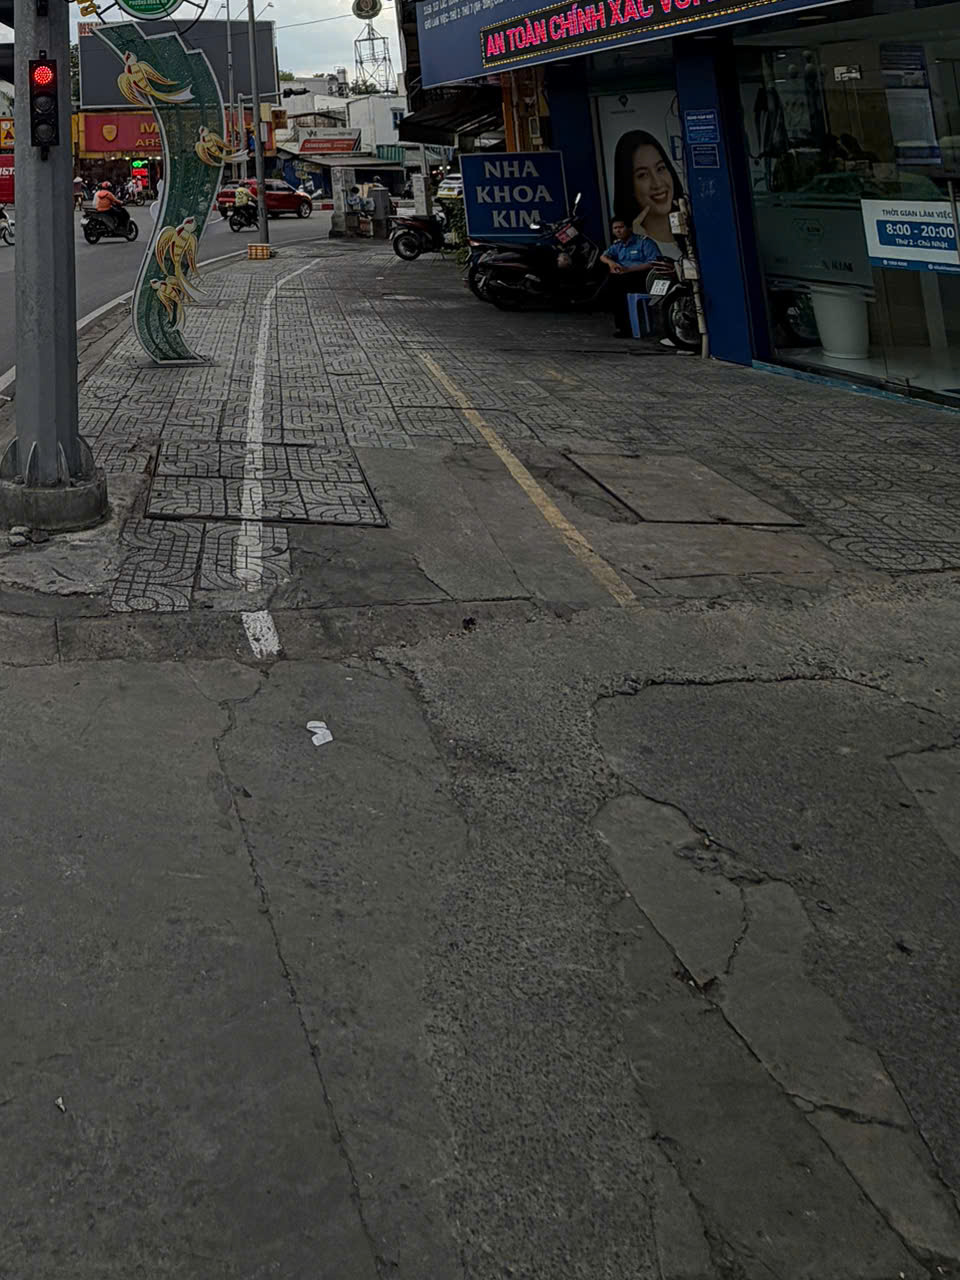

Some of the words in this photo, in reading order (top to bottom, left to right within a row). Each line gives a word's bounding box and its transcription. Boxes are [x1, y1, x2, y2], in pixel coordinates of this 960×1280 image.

[486, 32, 505, 57] AN
[508, 17, 548, 53] TOÀN
[549, 2, 605, 41] CHÍNH
[483, 160, 540, 178] NHA
[475, 184, 554, 204] KHOA
[492, 209, 542, 228] KIM
[882, 209, 899, 217] THỜI
[919, 209, 934, 218] LÀM
[935, 210, 953, 219] VIỆC
[886, 223, 911, 235] 8:00
[921, 225, 955, 238] 20:00
